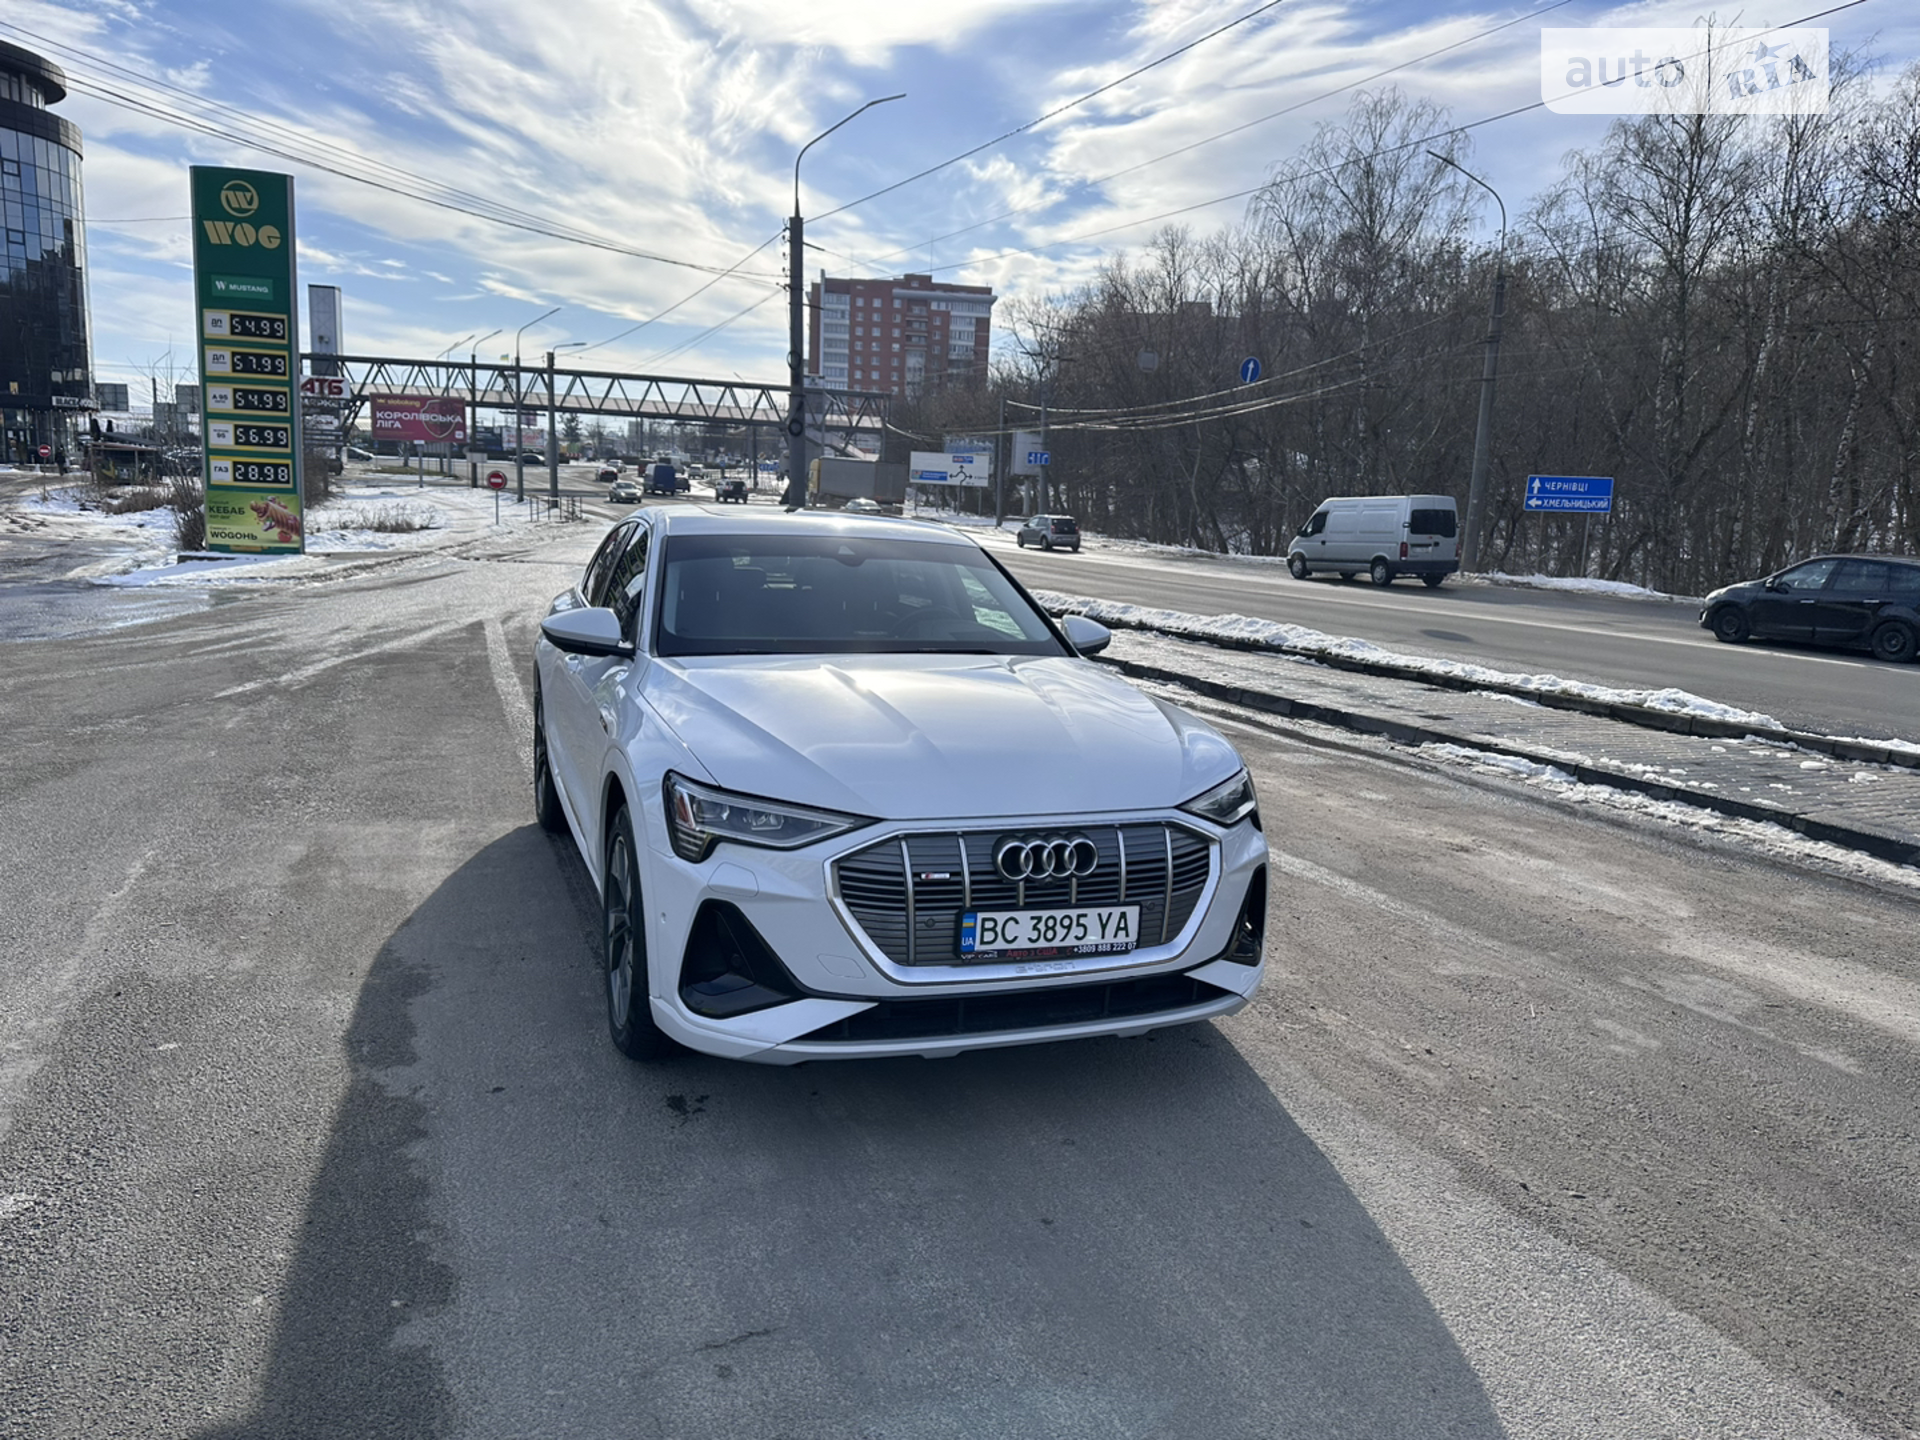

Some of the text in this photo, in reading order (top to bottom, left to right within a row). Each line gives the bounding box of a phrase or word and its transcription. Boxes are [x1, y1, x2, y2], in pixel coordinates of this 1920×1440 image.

[203, 220, 281, 249] WOG
[229, 284, 269, 293] MUSTANG
[232, 318, 284, 337] 54.99
[234, 355, 285, 373] 57.99
[300, 378, 345, 397] АТБ
[235, 392, 286, 409] 54.99
[376, 411, 464, 423] КОРОЛІВСЬКА
[376, 420, 402, 429] ЛІГА
[236, 428, 287, 445] 56.99
[235, 465, 288, 482] 28.98
[1545, 481, 1589, 492] ЧЕРНІВЦІ
[208, 505, 245, 515] КЕБАБ
[1542, 498, 1609, 509] ХМЕЛЬНИЦЬКИЙ
[961, 911, 1130, 946] UA BC 3895 YA
[1006, 949, 1028, 957] Авто
[1036, 947, 1059, 956] США
[1112, 942, 1126, 951] 222
[1127, 942, 1137, 950] 07
